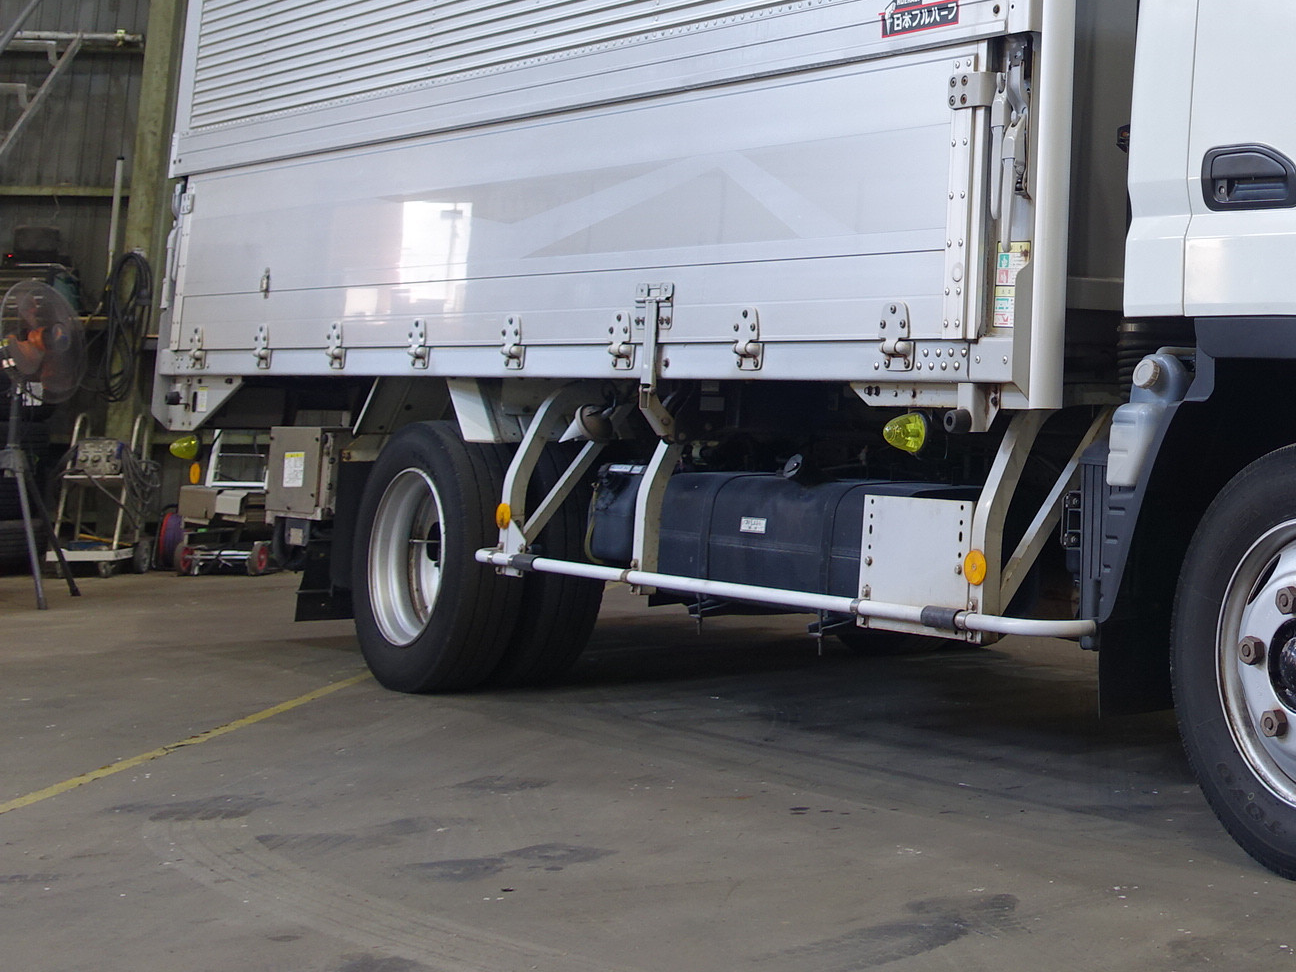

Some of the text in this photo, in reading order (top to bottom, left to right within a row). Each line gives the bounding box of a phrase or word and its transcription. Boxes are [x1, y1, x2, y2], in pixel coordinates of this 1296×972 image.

[893, 2, 957, 31] 日本フルハーフ
